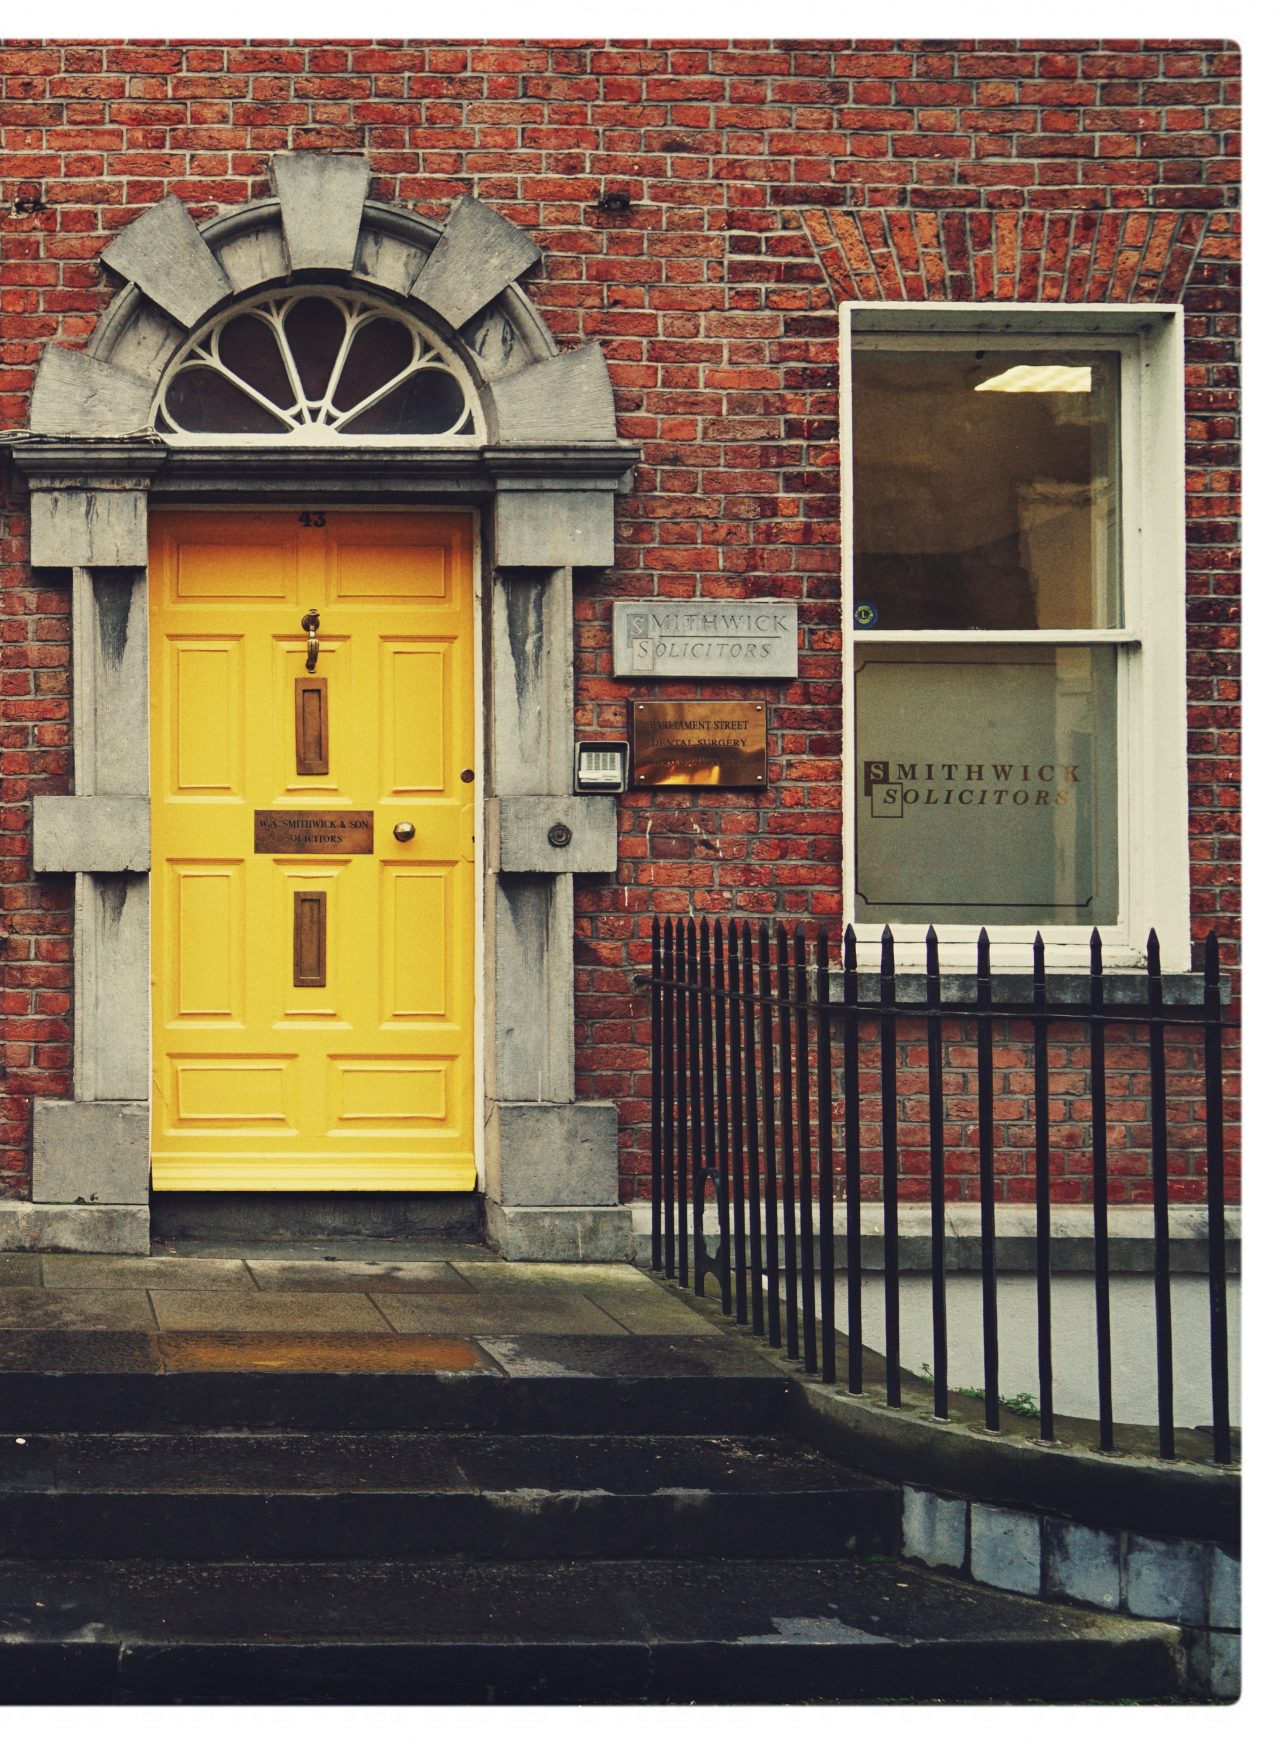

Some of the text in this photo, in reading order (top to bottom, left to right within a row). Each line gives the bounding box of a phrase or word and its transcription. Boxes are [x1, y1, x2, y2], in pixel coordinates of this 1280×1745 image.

[299, 511, 326, 528] 43
[631, 614, 789, 633] SMITHWICK
[637, 640, 771, 659] SOLICITORS
[650, 720, 749, 730] PARLIAMENT STREET
[651, 739, 748, 748] DENTAL SURGERY
[870, 763, 1081, 782] SMITHWICK
[883, 788, 1070, 806] SOLICITORS
[282, 819, 336, 829] SMITHWICK
[339, 819, 346, 829] &
[349, 819, 369, 829] SON
[285, 834, 343, 843] SOLICITORS
